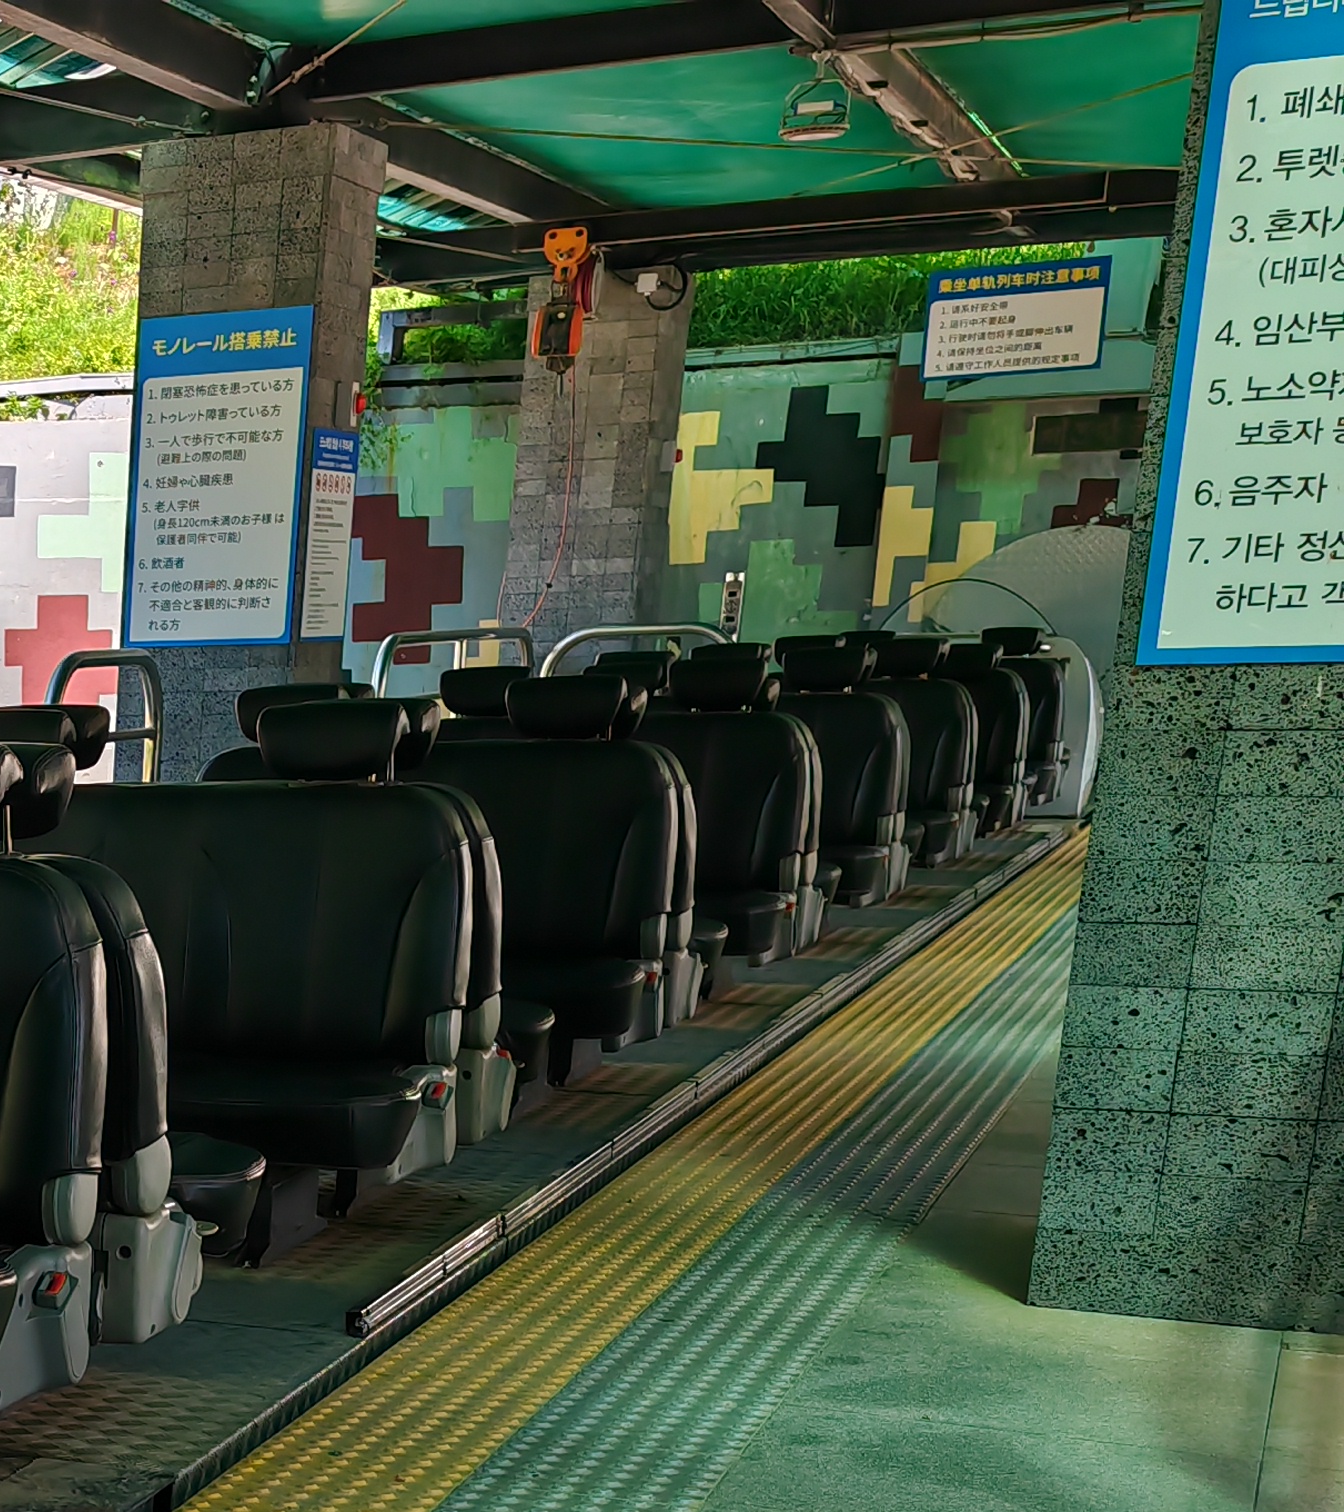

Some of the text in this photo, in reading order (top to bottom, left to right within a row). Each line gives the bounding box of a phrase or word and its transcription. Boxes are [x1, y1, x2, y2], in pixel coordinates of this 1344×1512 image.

[1247, 94, 1266, 122] 1.
[1236, 144, 1344, 183] 2. 투렛
[1229, 216, 1255, 243] 3.
[939, 266, 1100, 293] 乘坐单轨列车时注意事项
[152, 327, 297, 356] モノレール搭乗禁止
[1215, 320, 1241, 347] 4.
[148, 389, 157, 399] 1.
[1207, 369, 1344, 406] 5. 노소약
[147, 414, 156, 424] 2.
[1235, 417, 1324, 445] 보호자
[145, 438, 154, 448] 3.
[143, 479, 152, 488] 4.
[1194, 473, 1328, 507] 6. 음주자
[142, 503, 151, 513] 5.
[1187, 537, 1209, 565] 7.
[1222, 532, 1284, 563] 기타
[139, 557, 184, 569] 6. 飲酒者
[138, 583, 146, 593] 7.
[1216, 583, 1309, 613] 하다고
[148, 619, 180, 631] れる方
